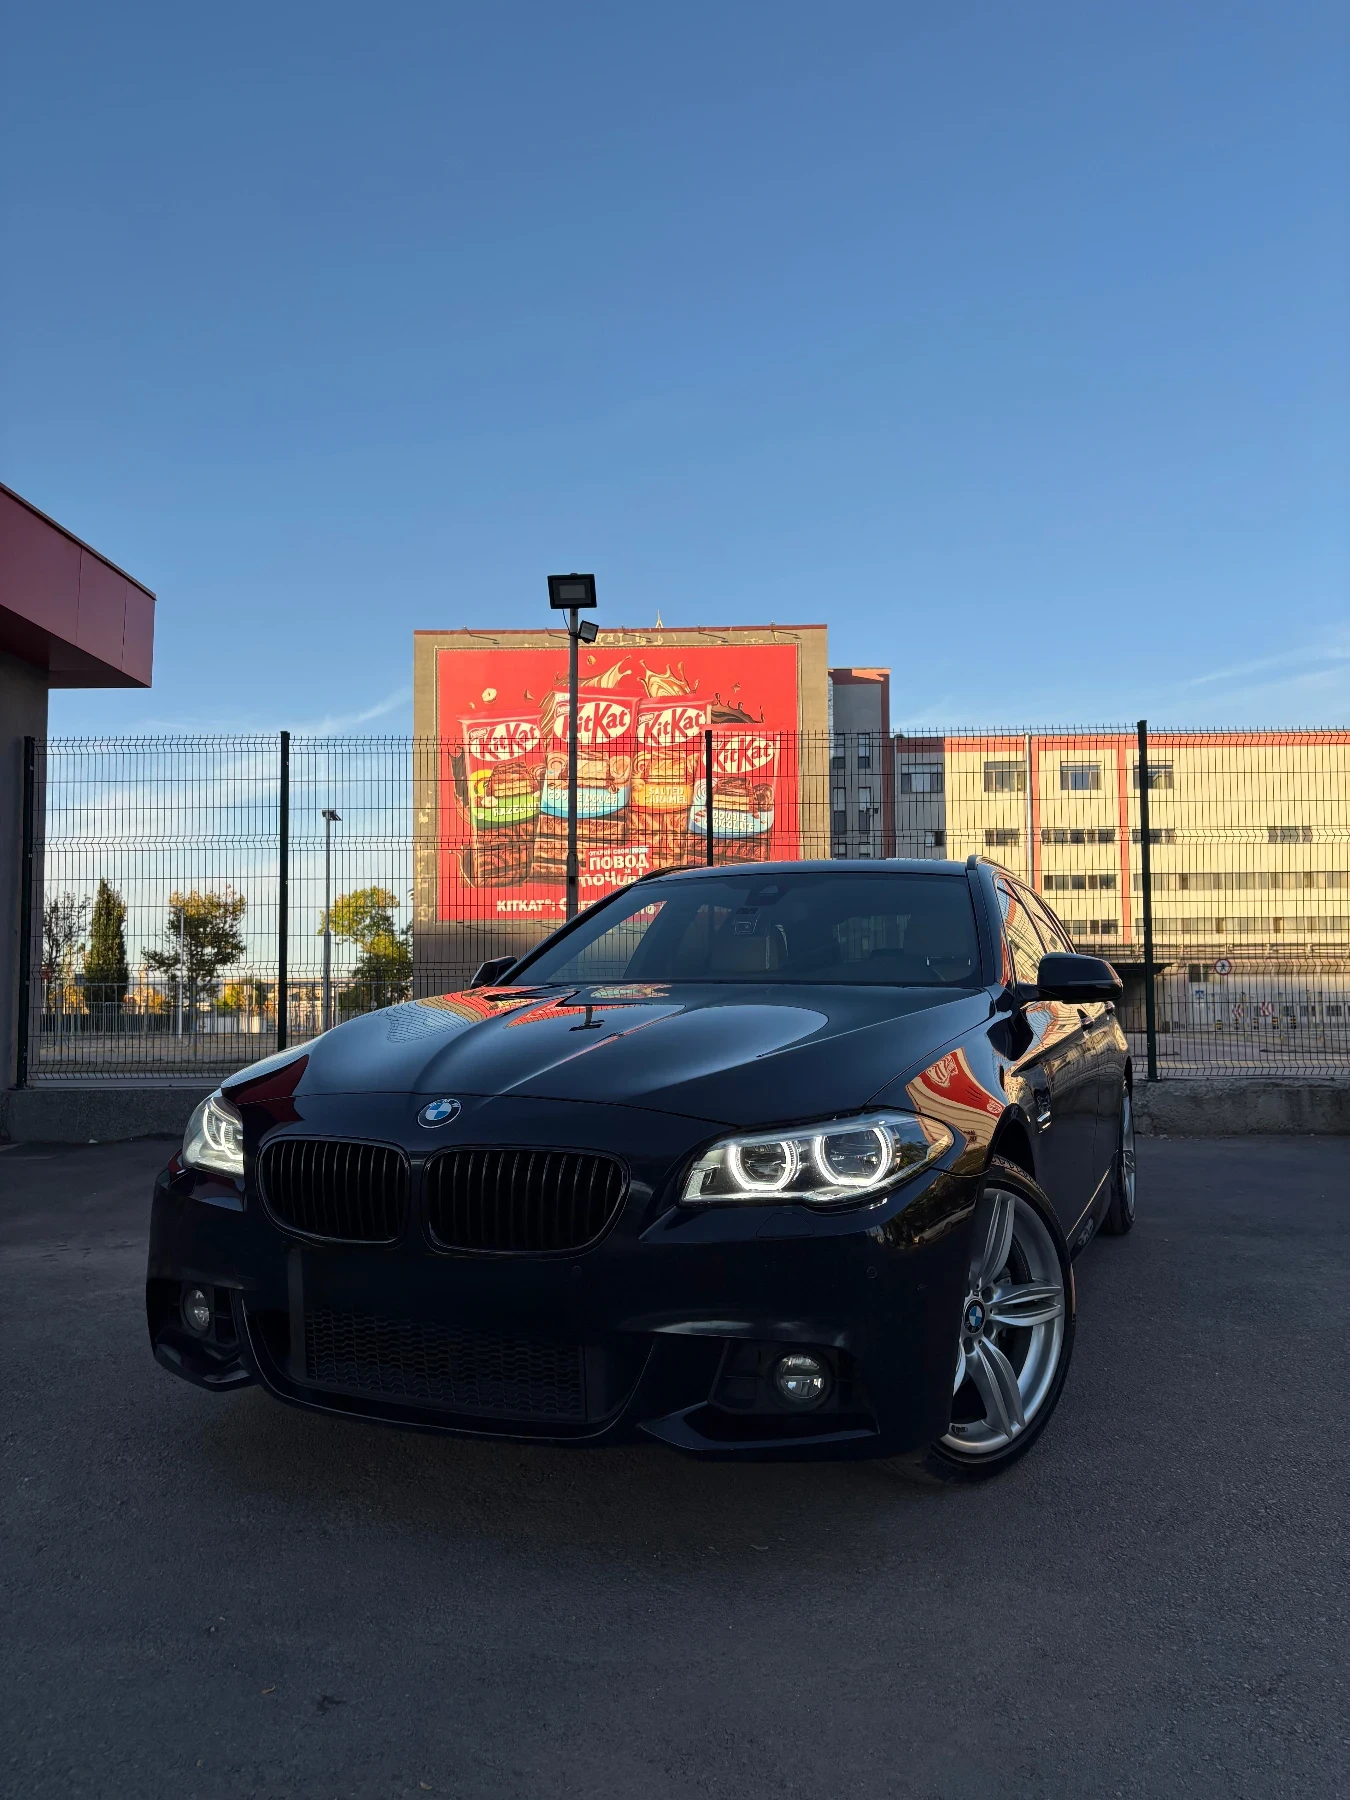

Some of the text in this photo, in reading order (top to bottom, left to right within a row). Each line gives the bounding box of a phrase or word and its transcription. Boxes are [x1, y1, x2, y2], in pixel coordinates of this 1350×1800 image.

[478, 723, 537, 760] KitKat
[644, 708, 703, 745] KitKat
[712, 738, 771, 772] KitKat
[548, 791, 583, 802] COOE
[589, 854, 649, 871] ПОВОД
